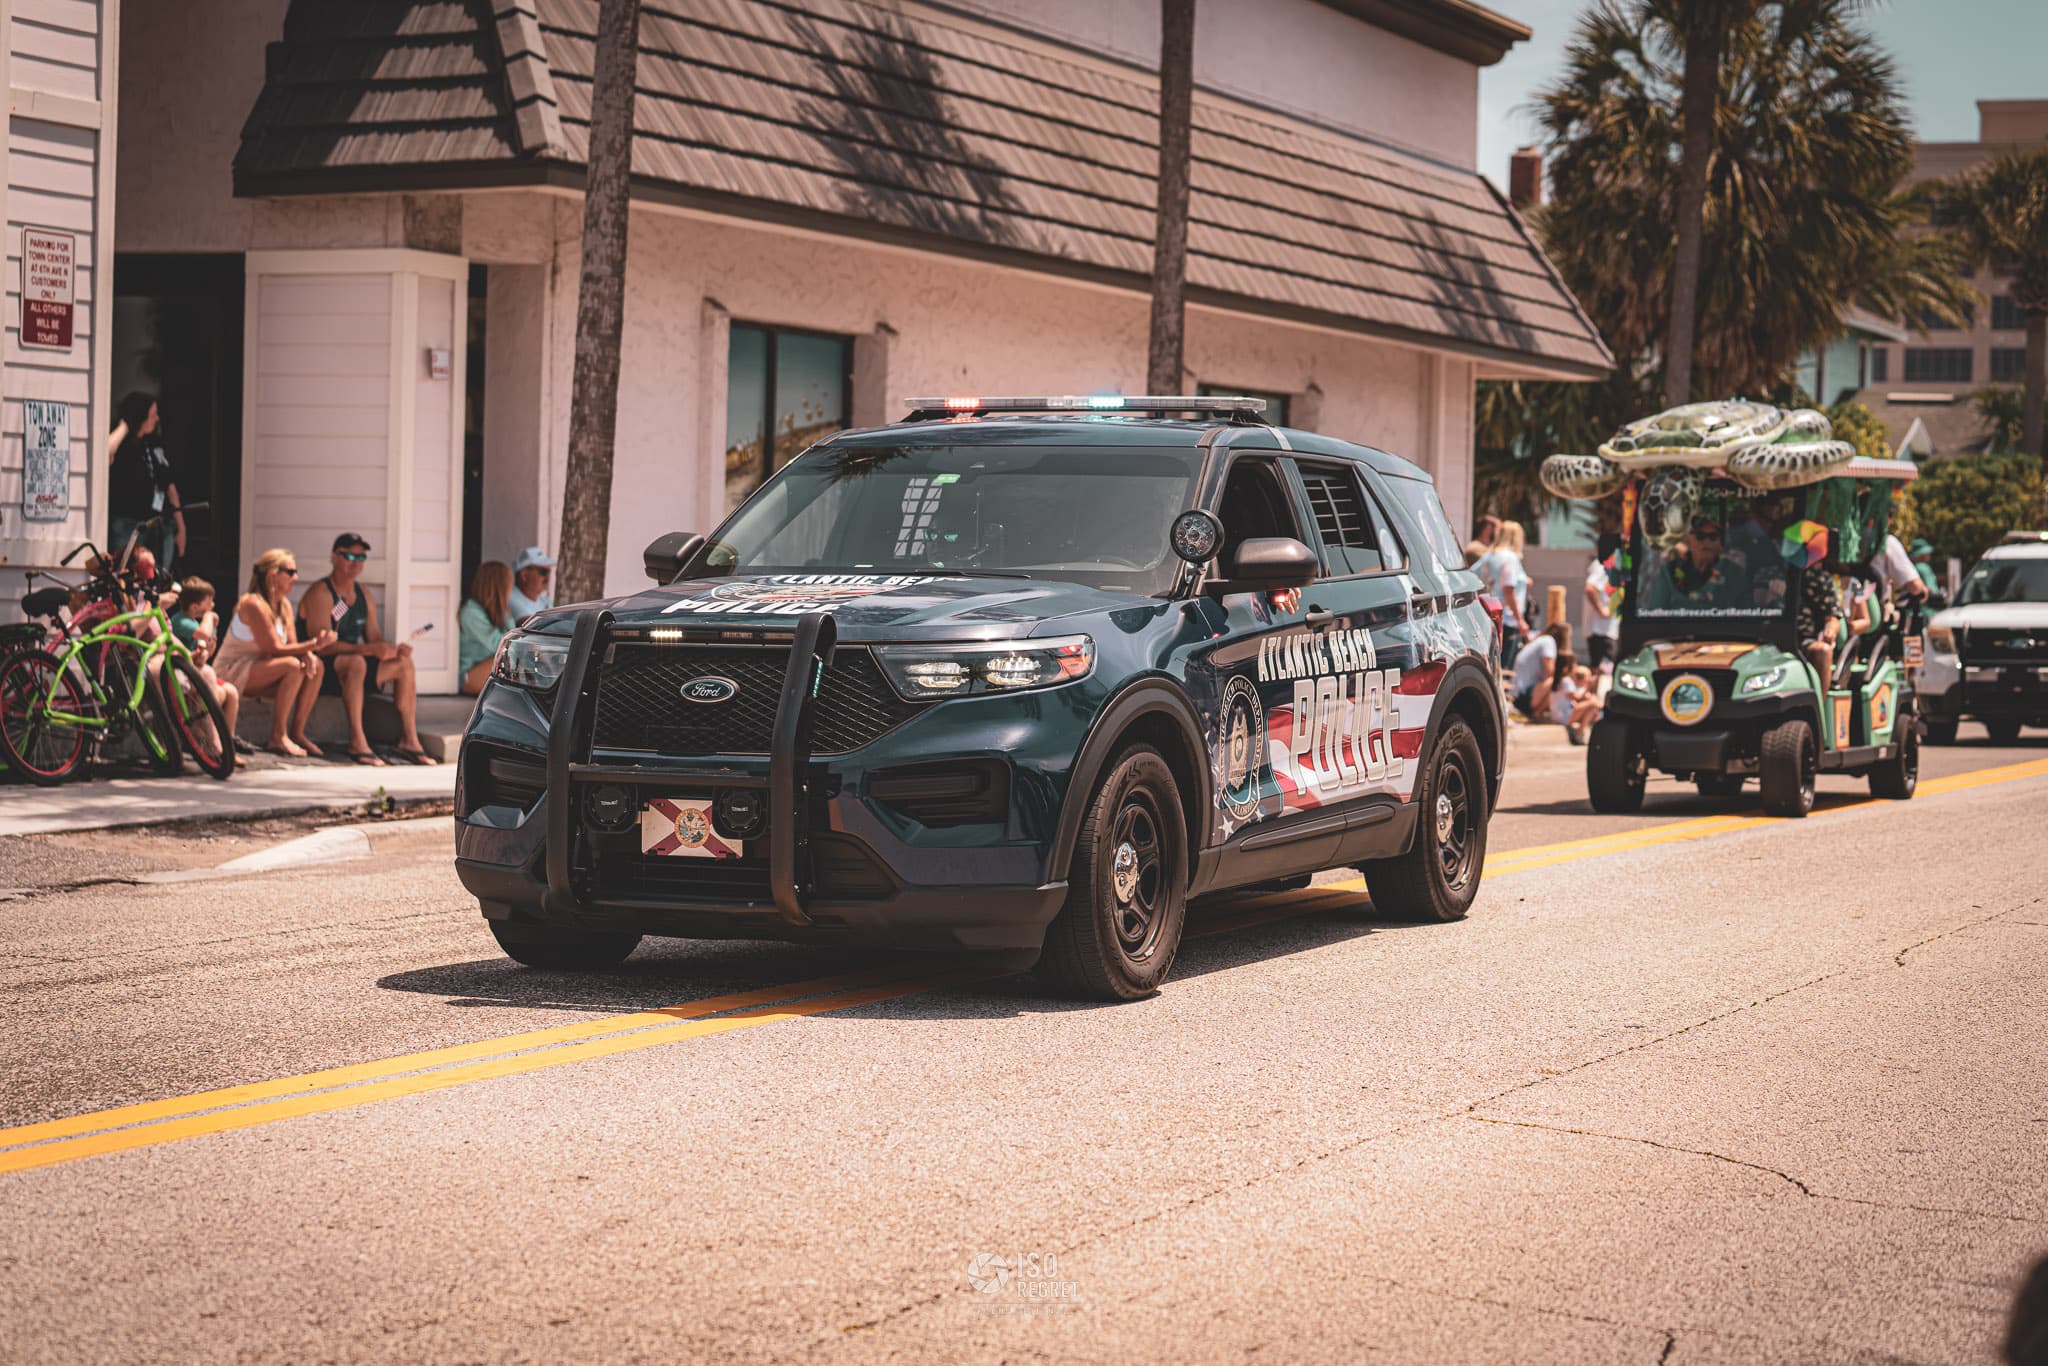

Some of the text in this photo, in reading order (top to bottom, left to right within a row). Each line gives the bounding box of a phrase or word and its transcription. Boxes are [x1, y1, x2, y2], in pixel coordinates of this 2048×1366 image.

[30, 238, 69, 251] PARKING FOR
[29, 250, 70, 264] TOWN CENTER
[31, 263, 37, 272] AT
[31, 275, 67, 288] CUSTOMERS
[41, 289, 56, 299] ONLY
[30, 301, 67, 316] ALL OTHERS
[36, 318, 60, 330] WILL BE
[37, 332, 59, 344] TOWED
[28, 402, 66, 426] TOW AWAY
[39, 426, 56, 448] ZONE
[770, 575, 940, 586] TLANTIC BEA
[661, 599, 840, 614] POLICE
[1257, 628, 1377, 683] ATLANTIC BEACH
[691, 683, 722, 697] Ford
[1289, 667, 1403, 796] POLICE
